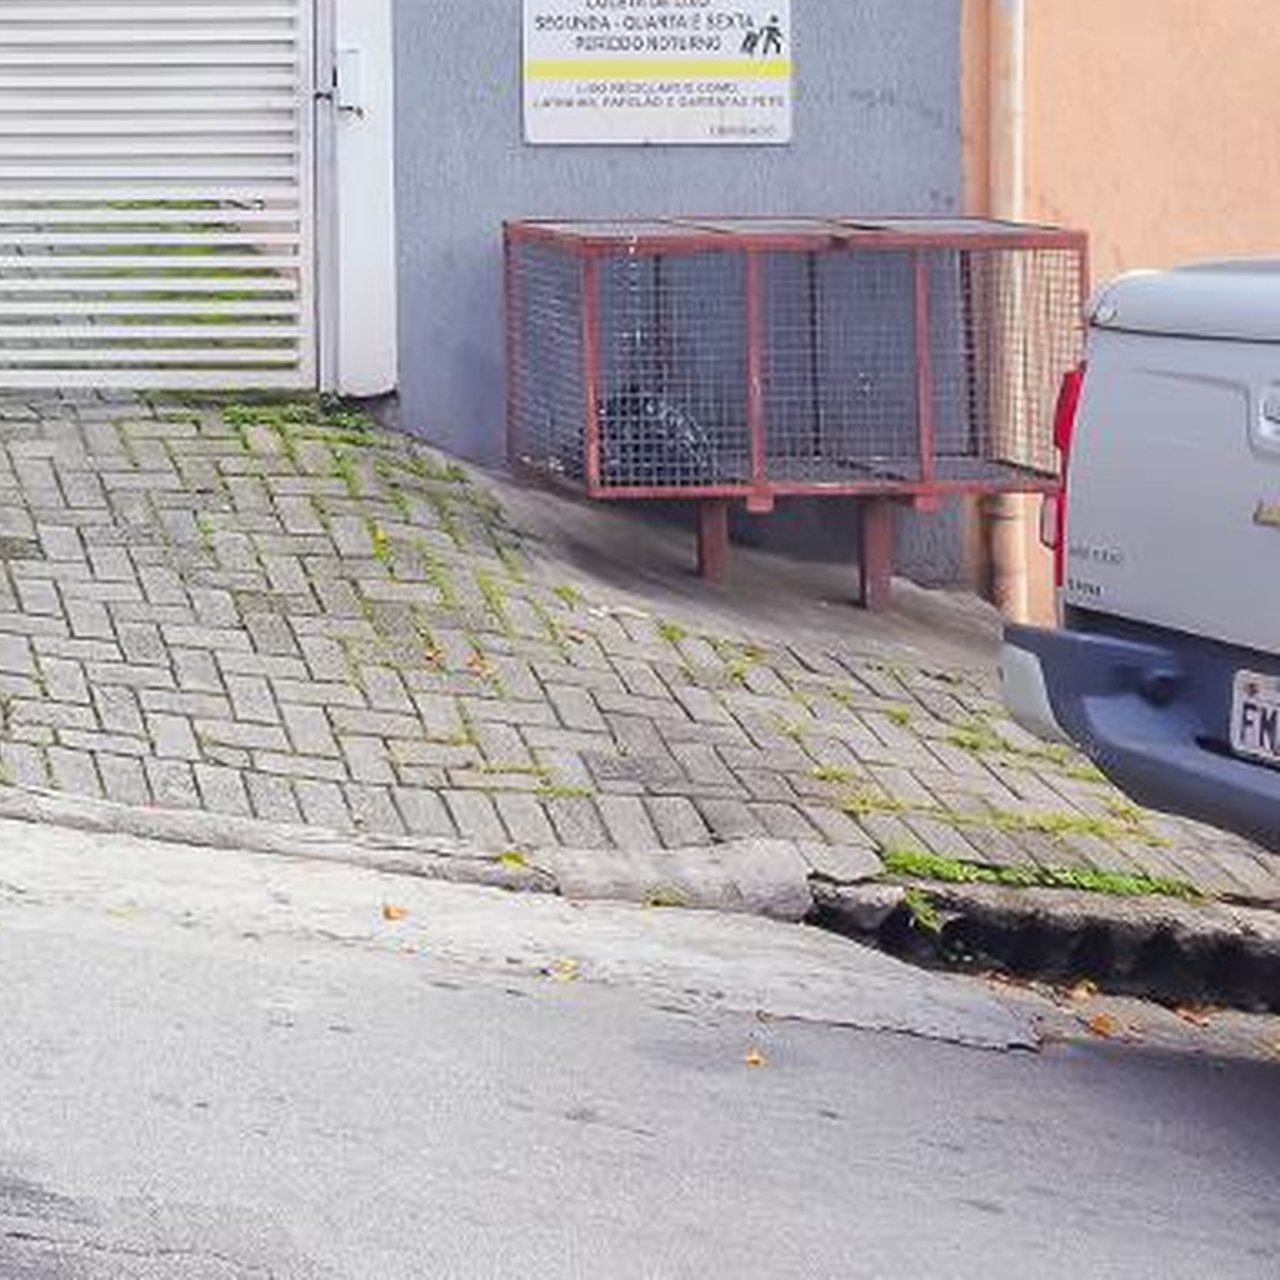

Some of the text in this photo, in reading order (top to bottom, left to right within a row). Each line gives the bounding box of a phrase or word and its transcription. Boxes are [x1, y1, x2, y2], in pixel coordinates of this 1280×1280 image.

[534, 14, 611, 32] SEGUNDA
[622, 14, 688, 31] QUARTA
[705, 11, 755, 30] SEXTA
[645, 35, 722, 52] NOTURNO
